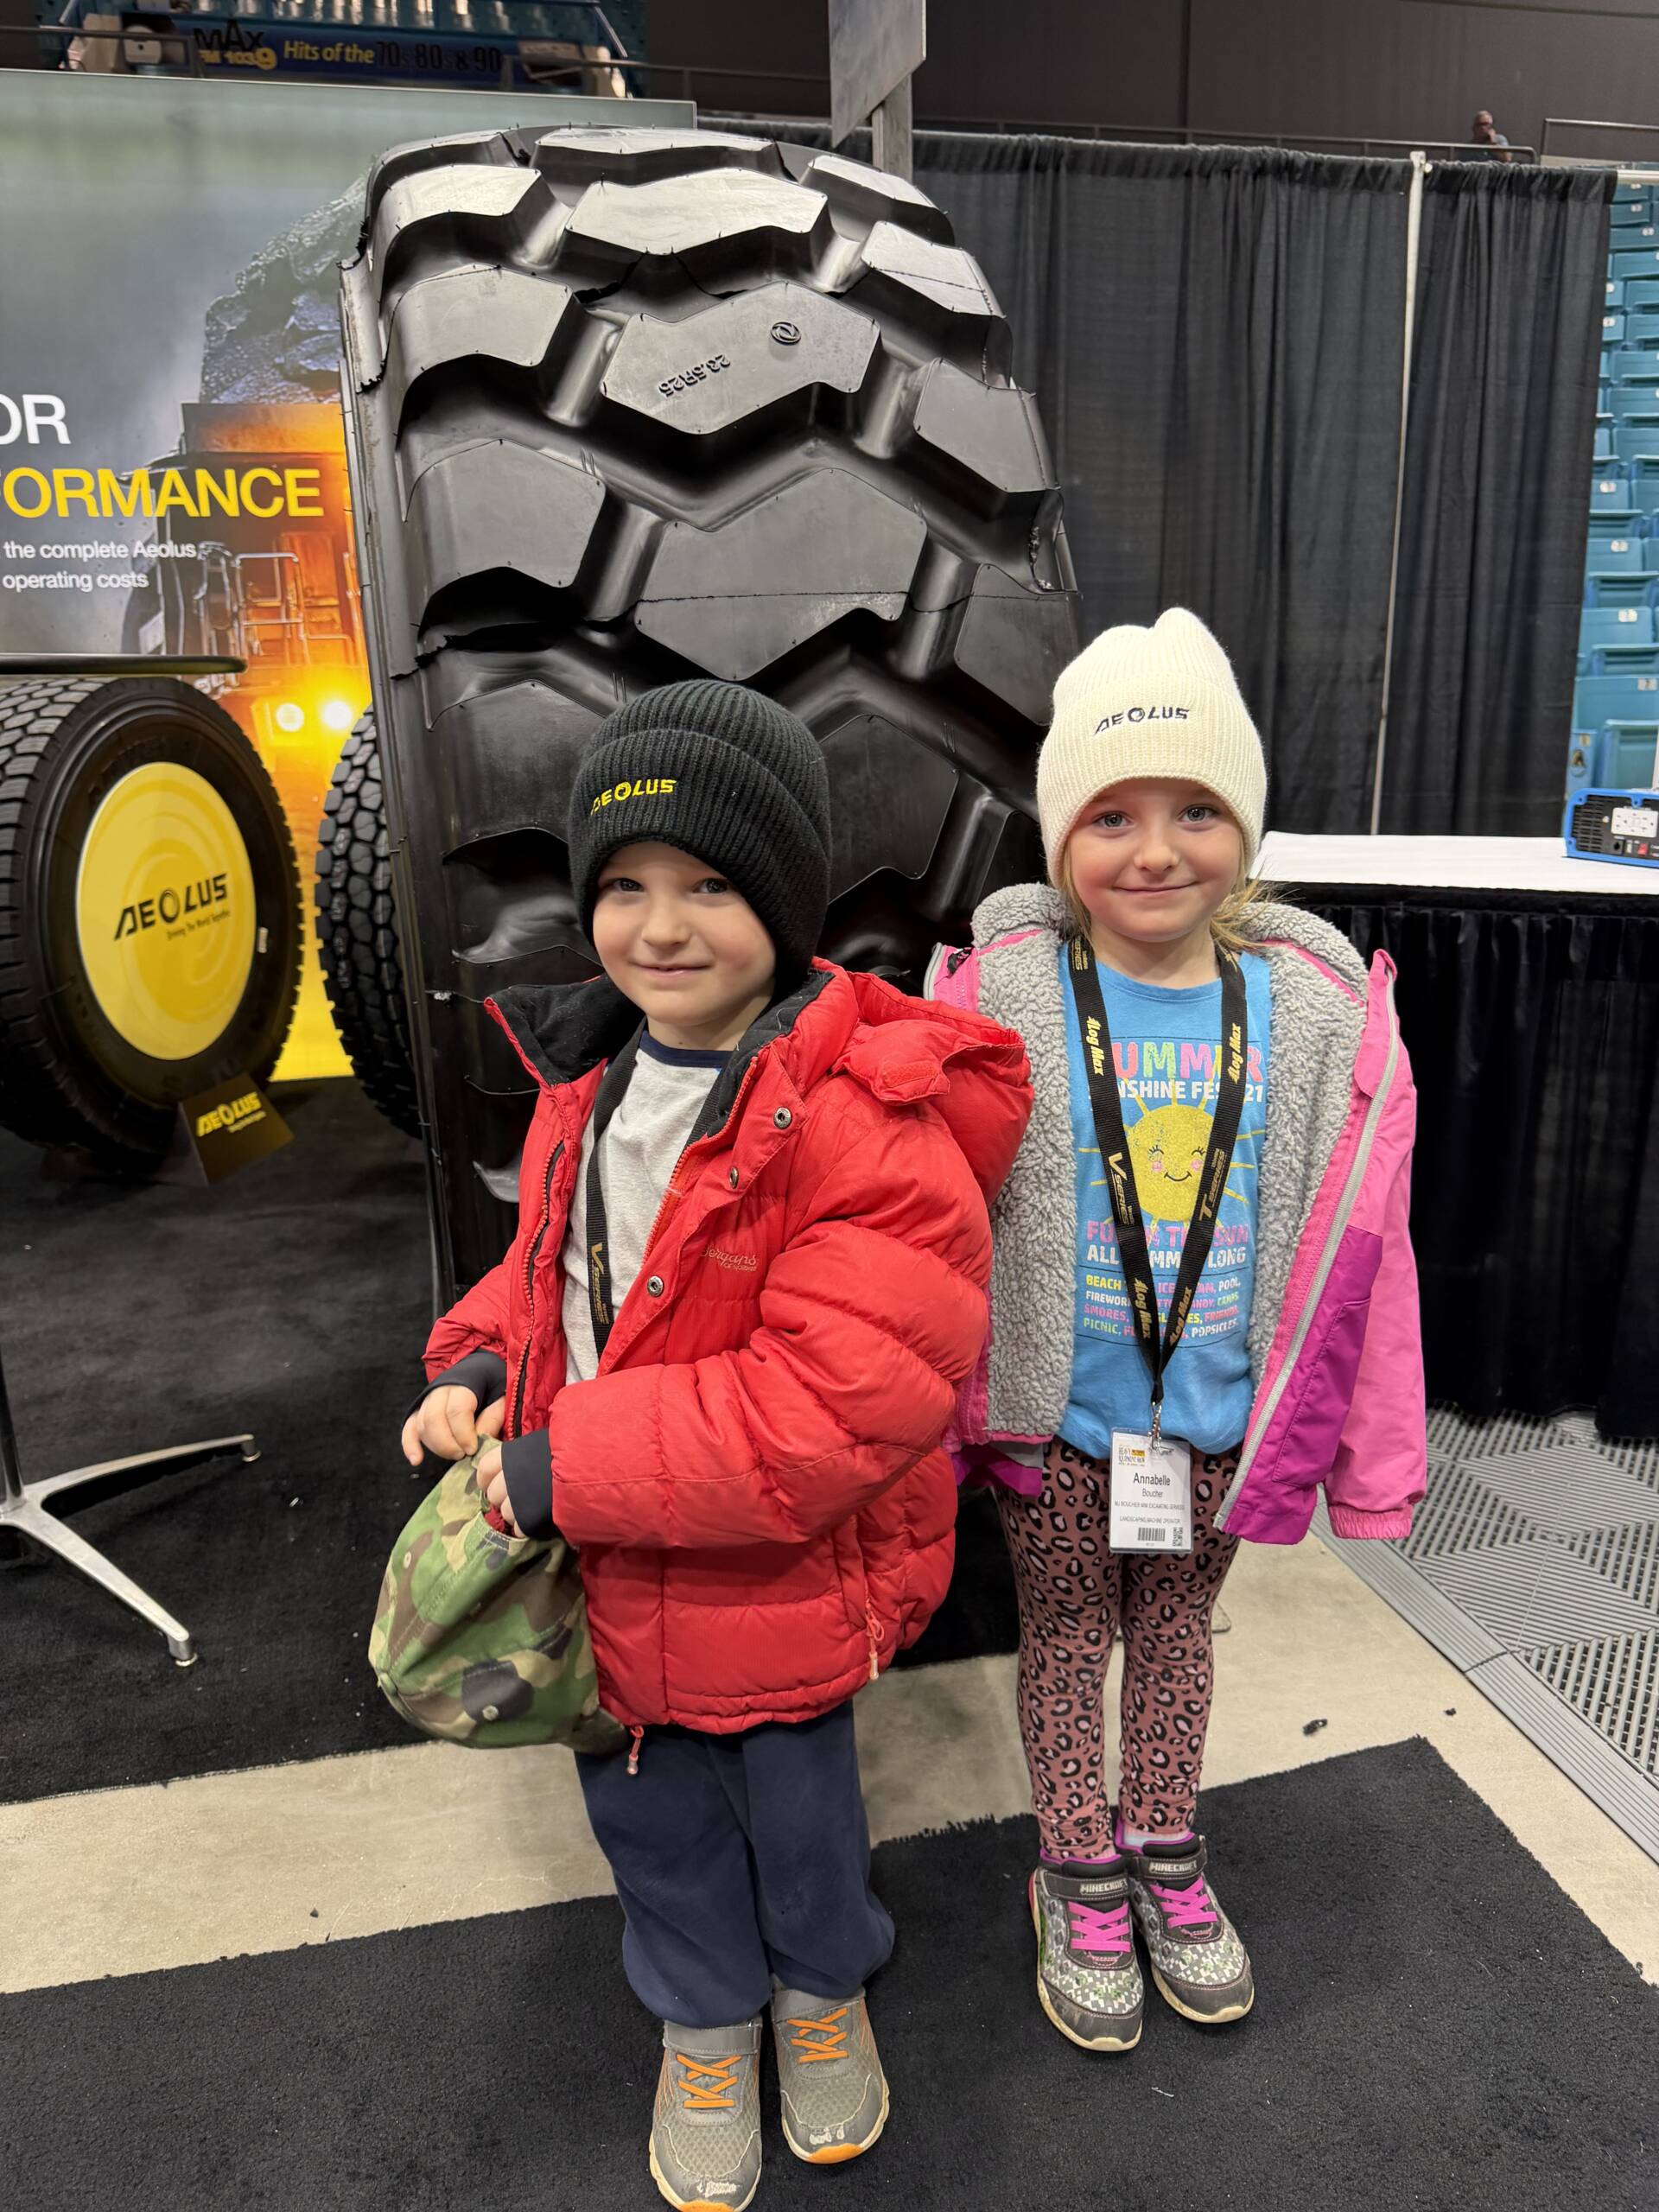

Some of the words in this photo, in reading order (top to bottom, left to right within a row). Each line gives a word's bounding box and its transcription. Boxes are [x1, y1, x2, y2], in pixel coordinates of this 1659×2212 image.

[284, 41, 320, 60] Hits
[321, 41, 344, 61] of
[345, 42, 374, 64] the
[0, 467, 324, 518] ORMANCE
[3, 541, 36, 559] the
[40, 541, 130, 563] complete
[133, 541, 197, 559] Aeolus
[3, 570, 93, 593] operating
[97, 573, 149, 589] costs
[1093, 705, 1190, 735] AEOLUS
[590, 779, 677, 816] AEOLUS
[114, 873, 227, 941] AEOLUS
[1229, 1023, 1241, 1053] Max
[1090, 1046, 1105, 1077] Max
[1111, 1041, 1263, 1082] UMMR
[196, 1091, 261, 1137] AEOLUS
[1087, 1244, 1120, 1266] ALL
[1086, 1274, 1122, 1291] BEACH
[1133, 1472, 1171, 1486] Annabelle
[1141, 1488, 1164, 1498] Boucher
[1149, 1859, 1198, 1874] MINECRAFT
[1079, 1877, 1128, 1894] MINECRAFT
